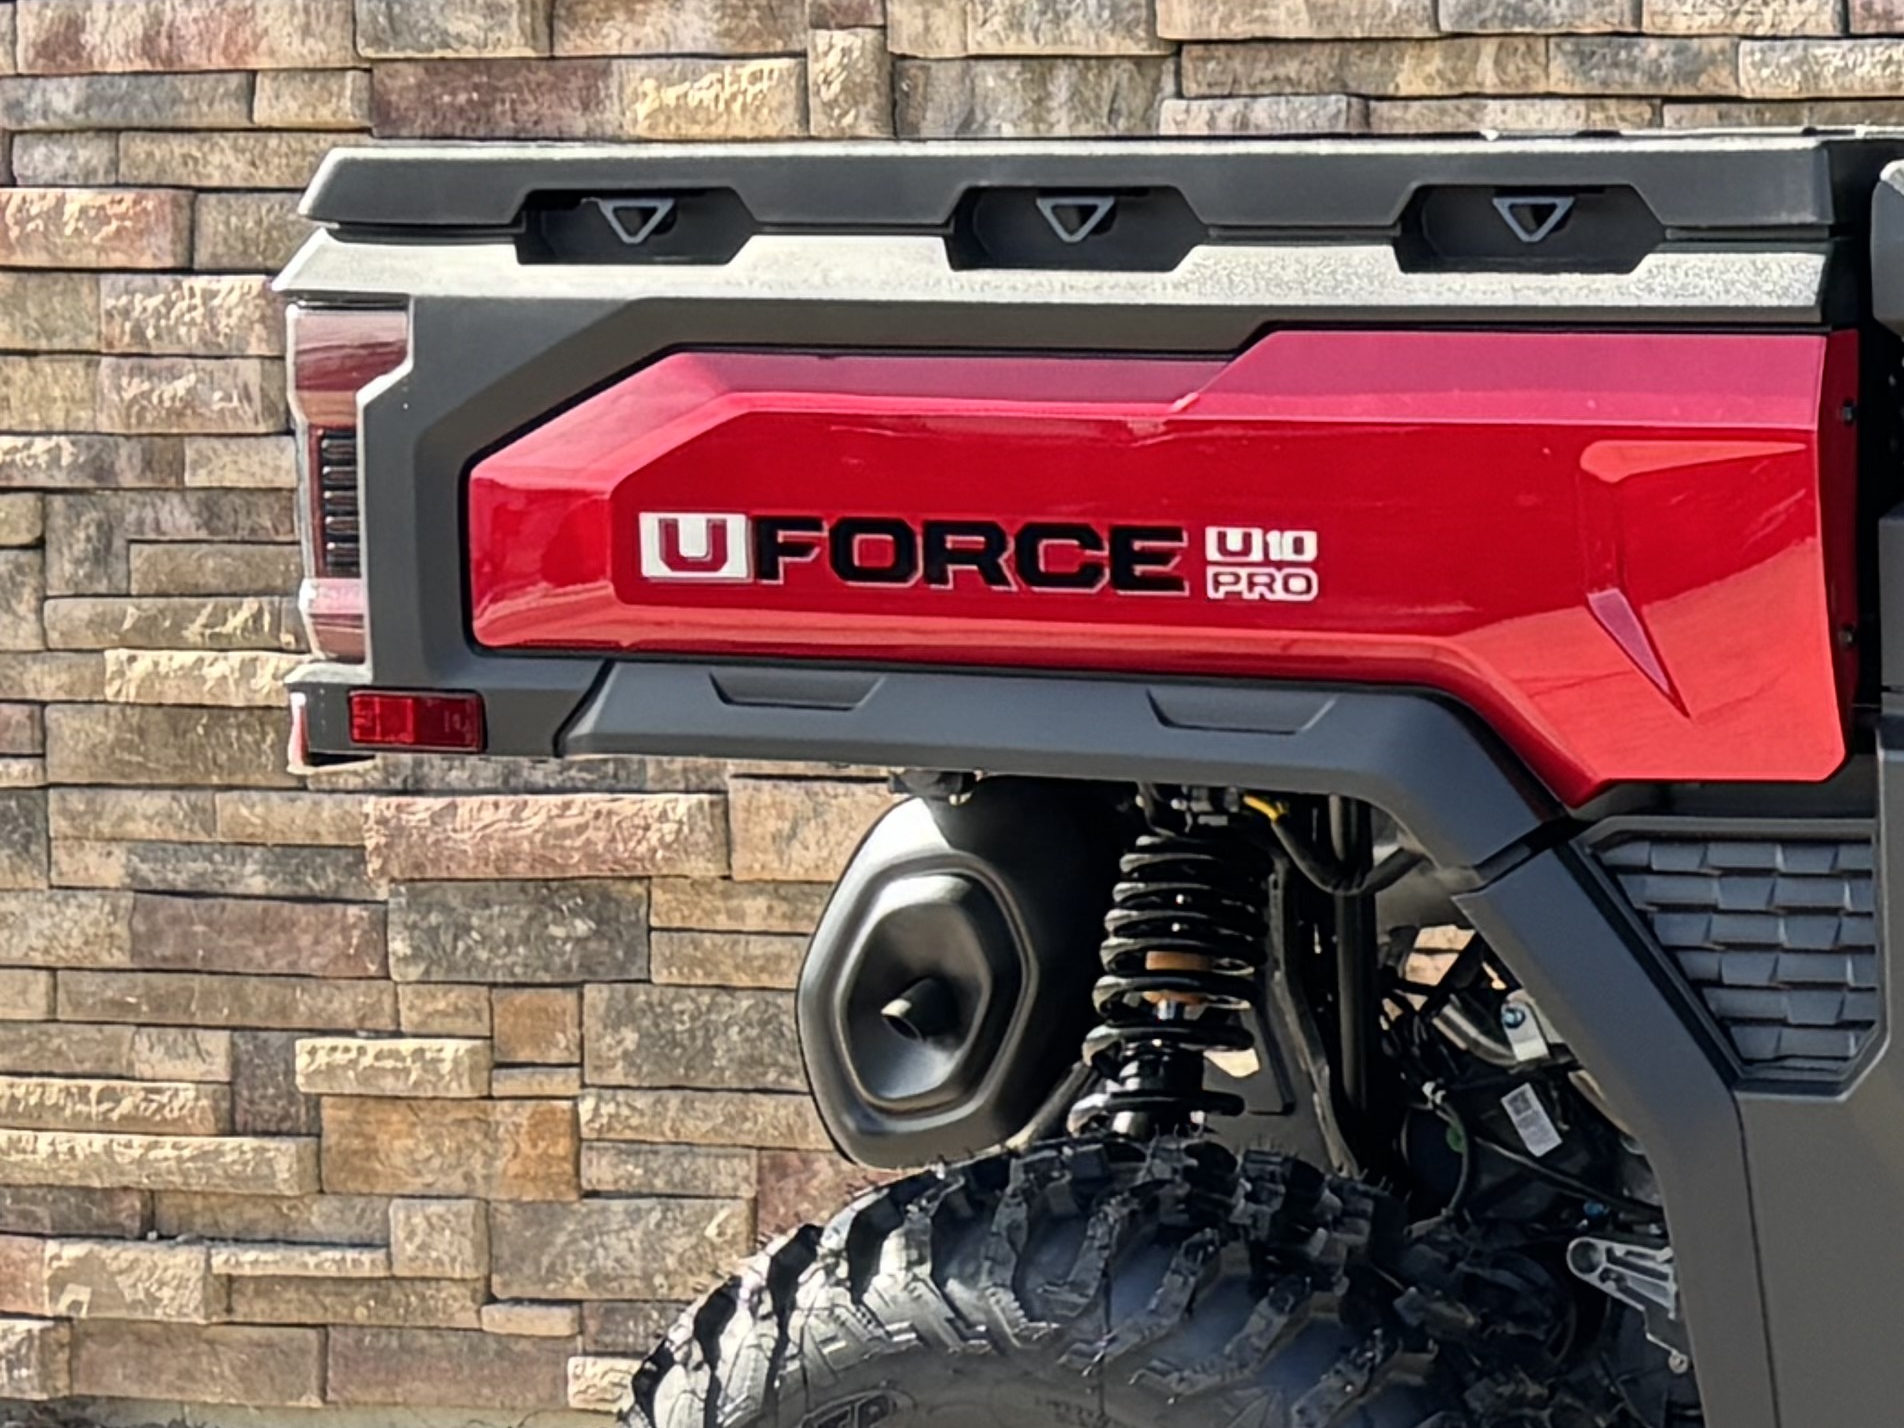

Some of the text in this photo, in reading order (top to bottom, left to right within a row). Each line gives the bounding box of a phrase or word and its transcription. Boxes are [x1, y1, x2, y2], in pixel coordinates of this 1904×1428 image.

[648, 515, 1188, 595] U FORCE
[1206, 527, 1317, 560] U10
[1207, 570, 1317, 599] PRO
